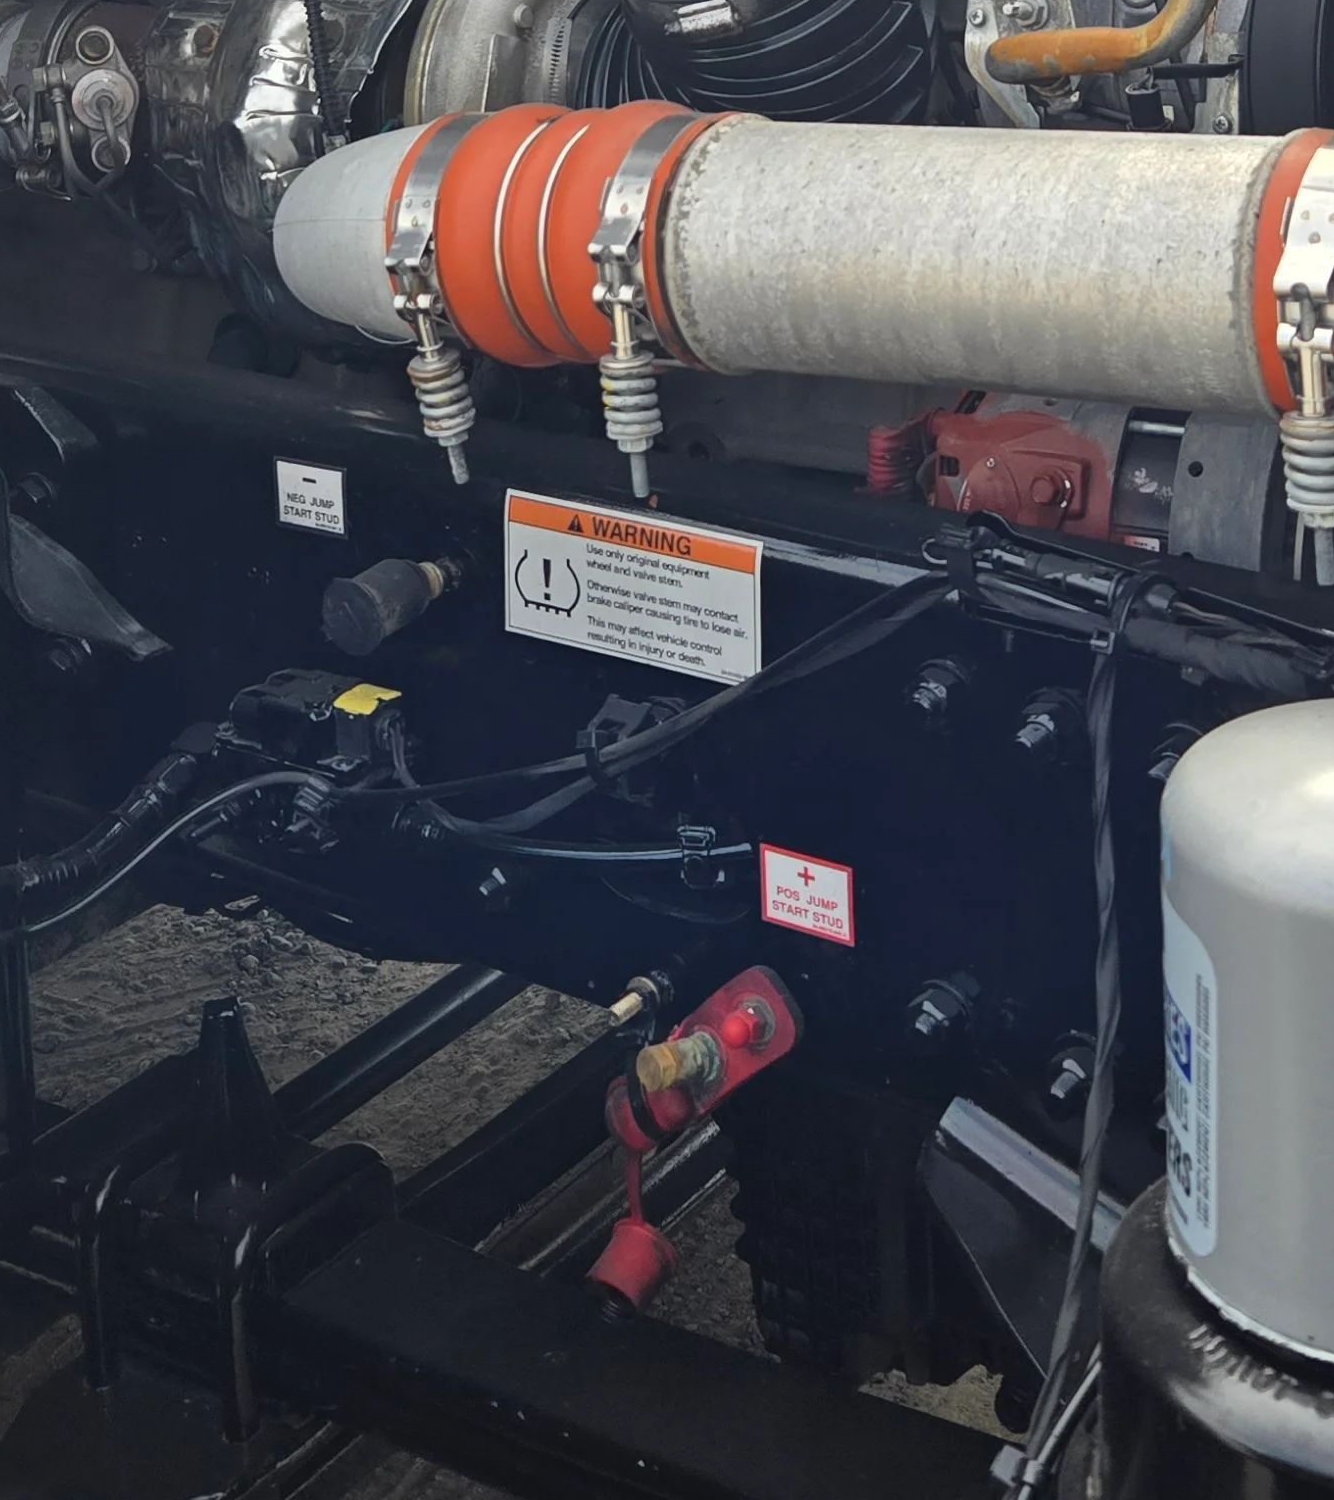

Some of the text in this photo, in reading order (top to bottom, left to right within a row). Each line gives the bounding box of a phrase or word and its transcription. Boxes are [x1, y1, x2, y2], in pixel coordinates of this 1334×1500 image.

[284, 505, 339, 525] START STUD
[287, 492, 334, 509] NEG JUMP
[592, 516, 692, 556] WARNING
[586, 543, 710, 580] Use only original equipment
[586, 559, 684, 588] wheel and valve stem.
[587, 579, 739, 624] Otherwise valve stem may contact
[587, 594, 749, 640] brake caliper causing tire to lose air.
[587, 615, 723, 656] This may affect vehicle control
[587, 631, 706, 666] resulting in injury or death.
[772, 900, 843, 929] START STUD
[776, 886, 838, 911] POS JUMP
